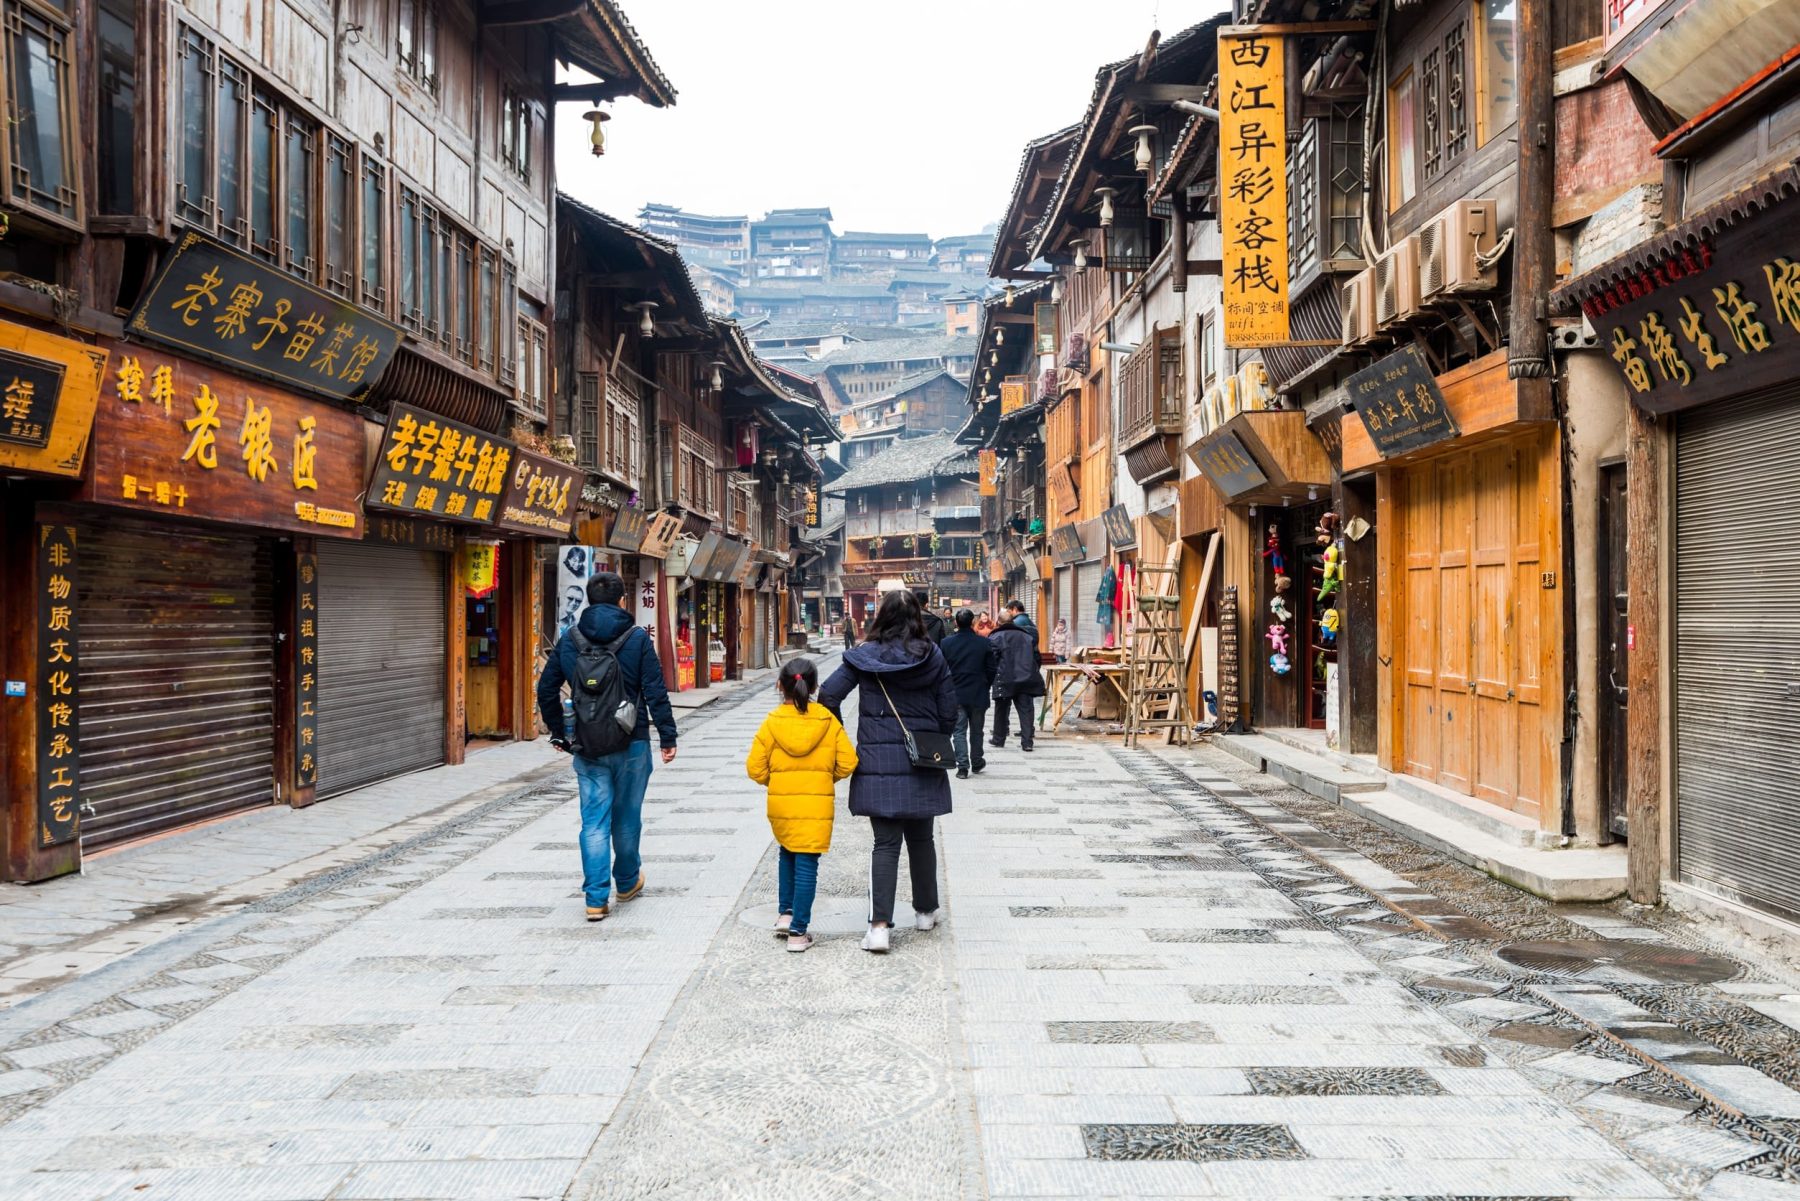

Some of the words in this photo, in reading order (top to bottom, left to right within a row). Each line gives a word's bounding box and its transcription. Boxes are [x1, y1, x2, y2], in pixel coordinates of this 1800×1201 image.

[1228, 34, 1280, 294] 西江异彩客栈
[171, 265, 380, 383] 老寨子苗菜馆
[47, 542, 73, 823] 非物质文化传承工艺
[641, 580, 656, 609] 米奶
